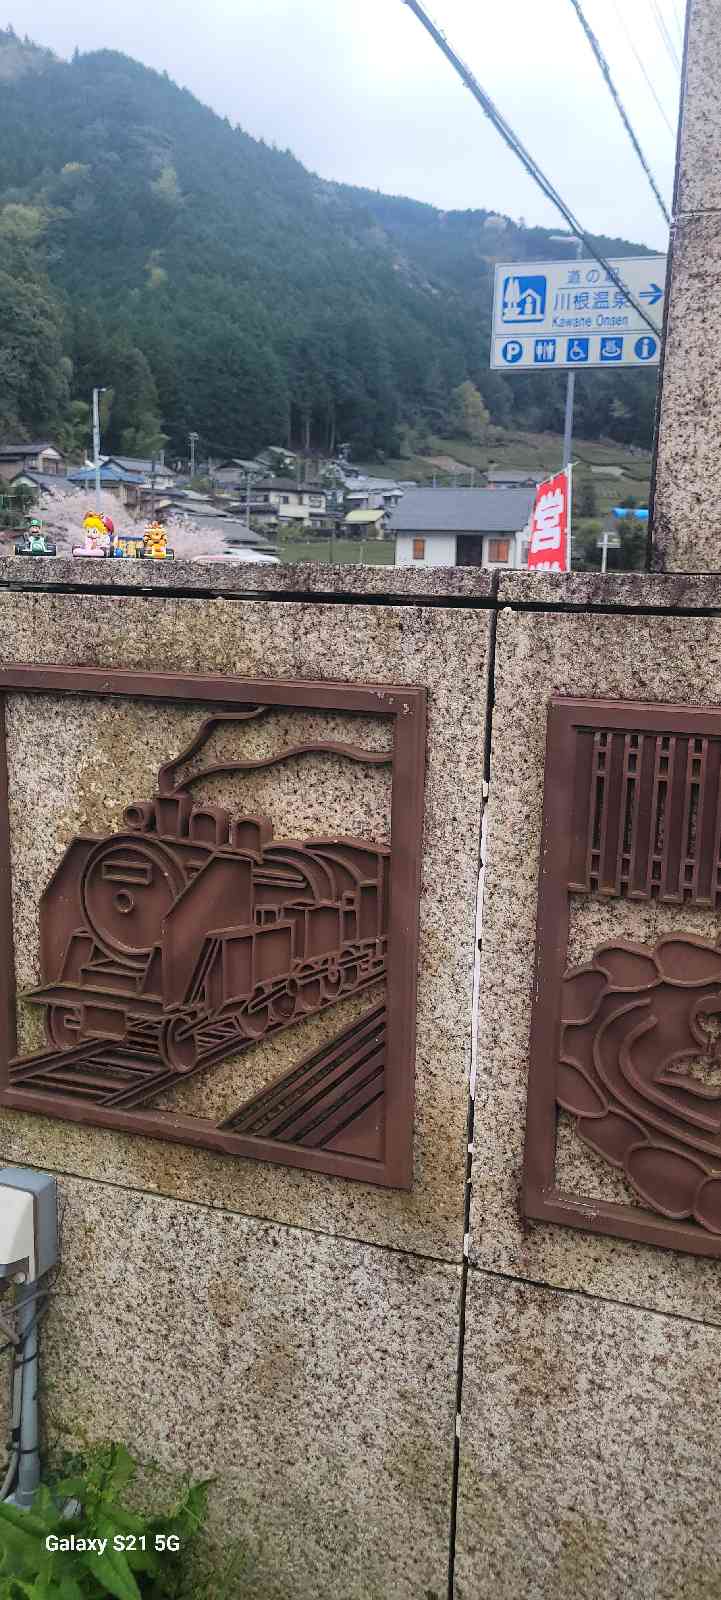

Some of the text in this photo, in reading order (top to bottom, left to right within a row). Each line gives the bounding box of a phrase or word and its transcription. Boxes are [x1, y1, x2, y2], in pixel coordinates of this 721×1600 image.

[552, 315, 628, 328] Kawane Onsen
[529, 488, 564, 571] 営
